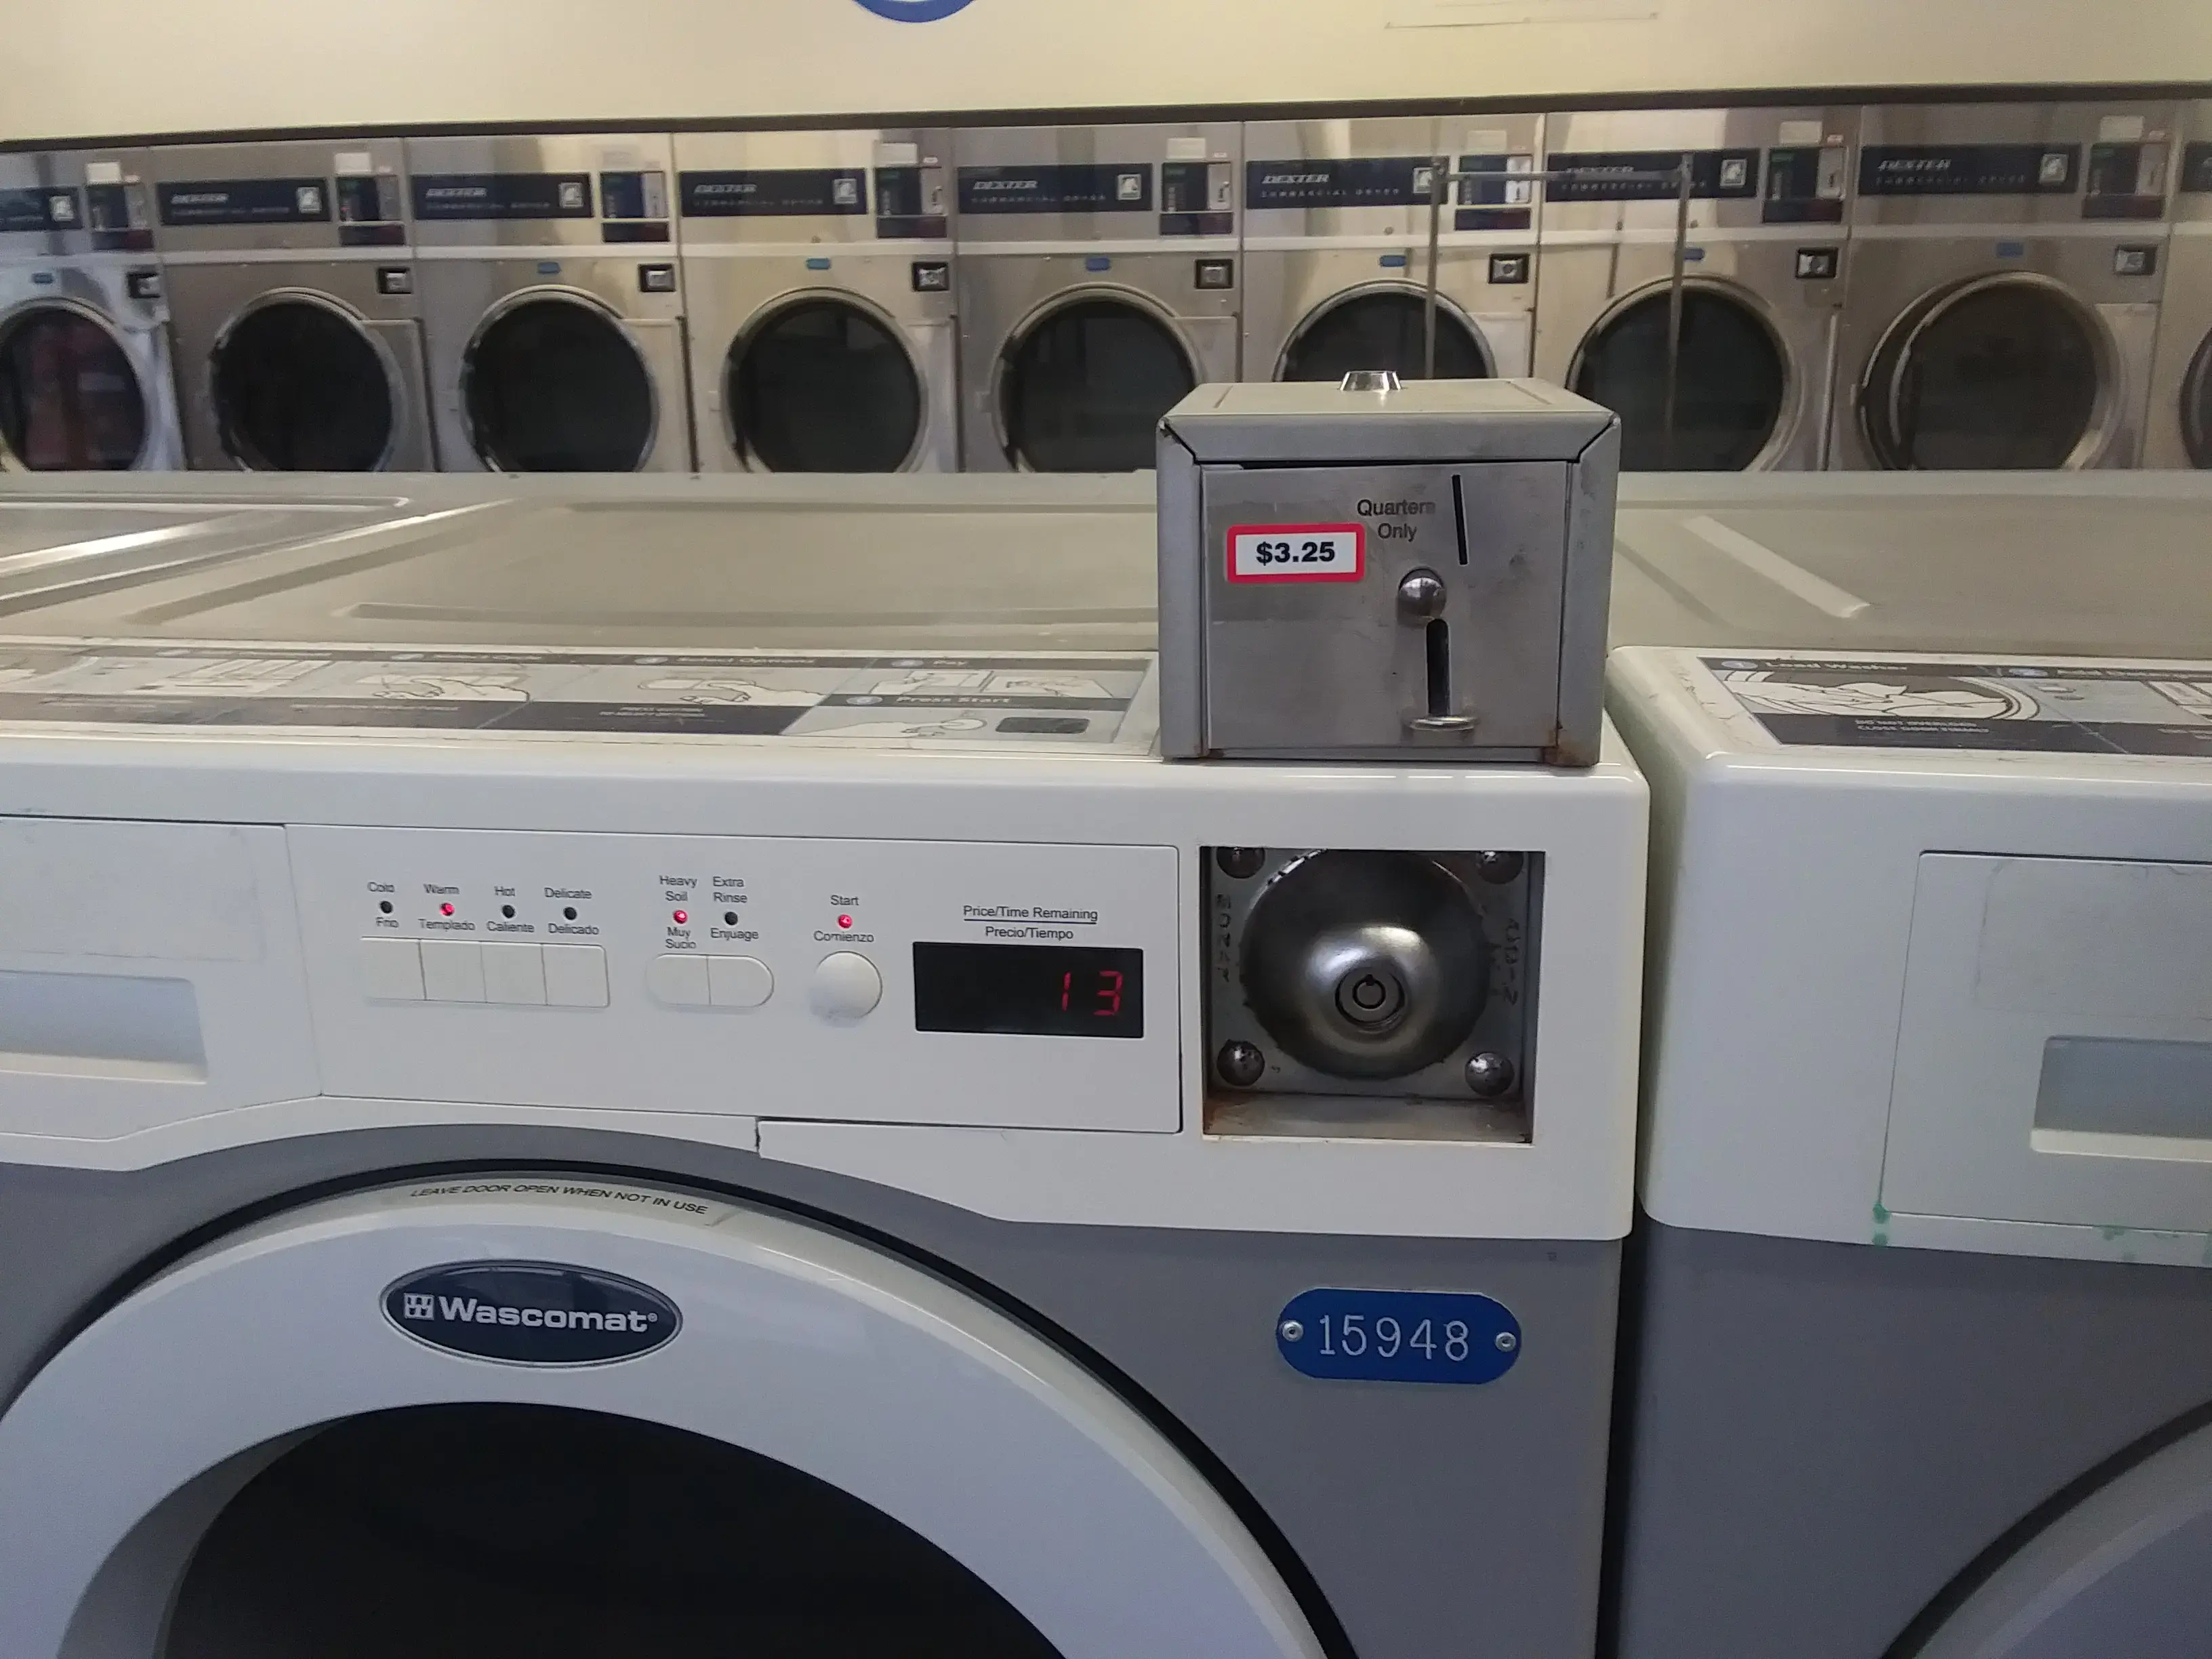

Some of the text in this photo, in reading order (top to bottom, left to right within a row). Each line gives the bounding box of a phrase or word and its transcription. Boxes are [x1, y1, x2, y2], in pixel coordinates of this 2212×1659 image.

[1357, 499, 1436, 516] Quarters
[1377, 523, 1418, 542] Only
[1256, 541, 1336, 566] $3.25
[367, 882, 395, 893] Cold
[659, 875, 698, 889] Heavy
[712, 876, 745, 888] Extra
[424, 883, 459, 895] Warm
[494, 886, 516, 897] Hot
[544, 887, 592, 900] Delicate
[665, 891, 689, 903] Soil
[713, 892, 747, 904] Rinse
[830, 895, 860, 906] Start
[963, 905, 1099, 922] Price/Time Remaining
[418, 918, 476, 933] Templado
[486, 920, 535, 933] Caliente
[548, 922, 599, 935] Delicado
[667, 927, 691, 942] Muy
[710, 928, 760, 941] Enjuage
[813, 930, 875, 943] Comienzo
[985, 926, 1074, 941] Precio/Tiempo
[410, 1185, 709, 1214] LEAVE DOOR OPEN WHEN NOT IN USE
[438, 1295, 649, 1333] Wascomat
[1319, 1300, 1470, 1361] 15948
